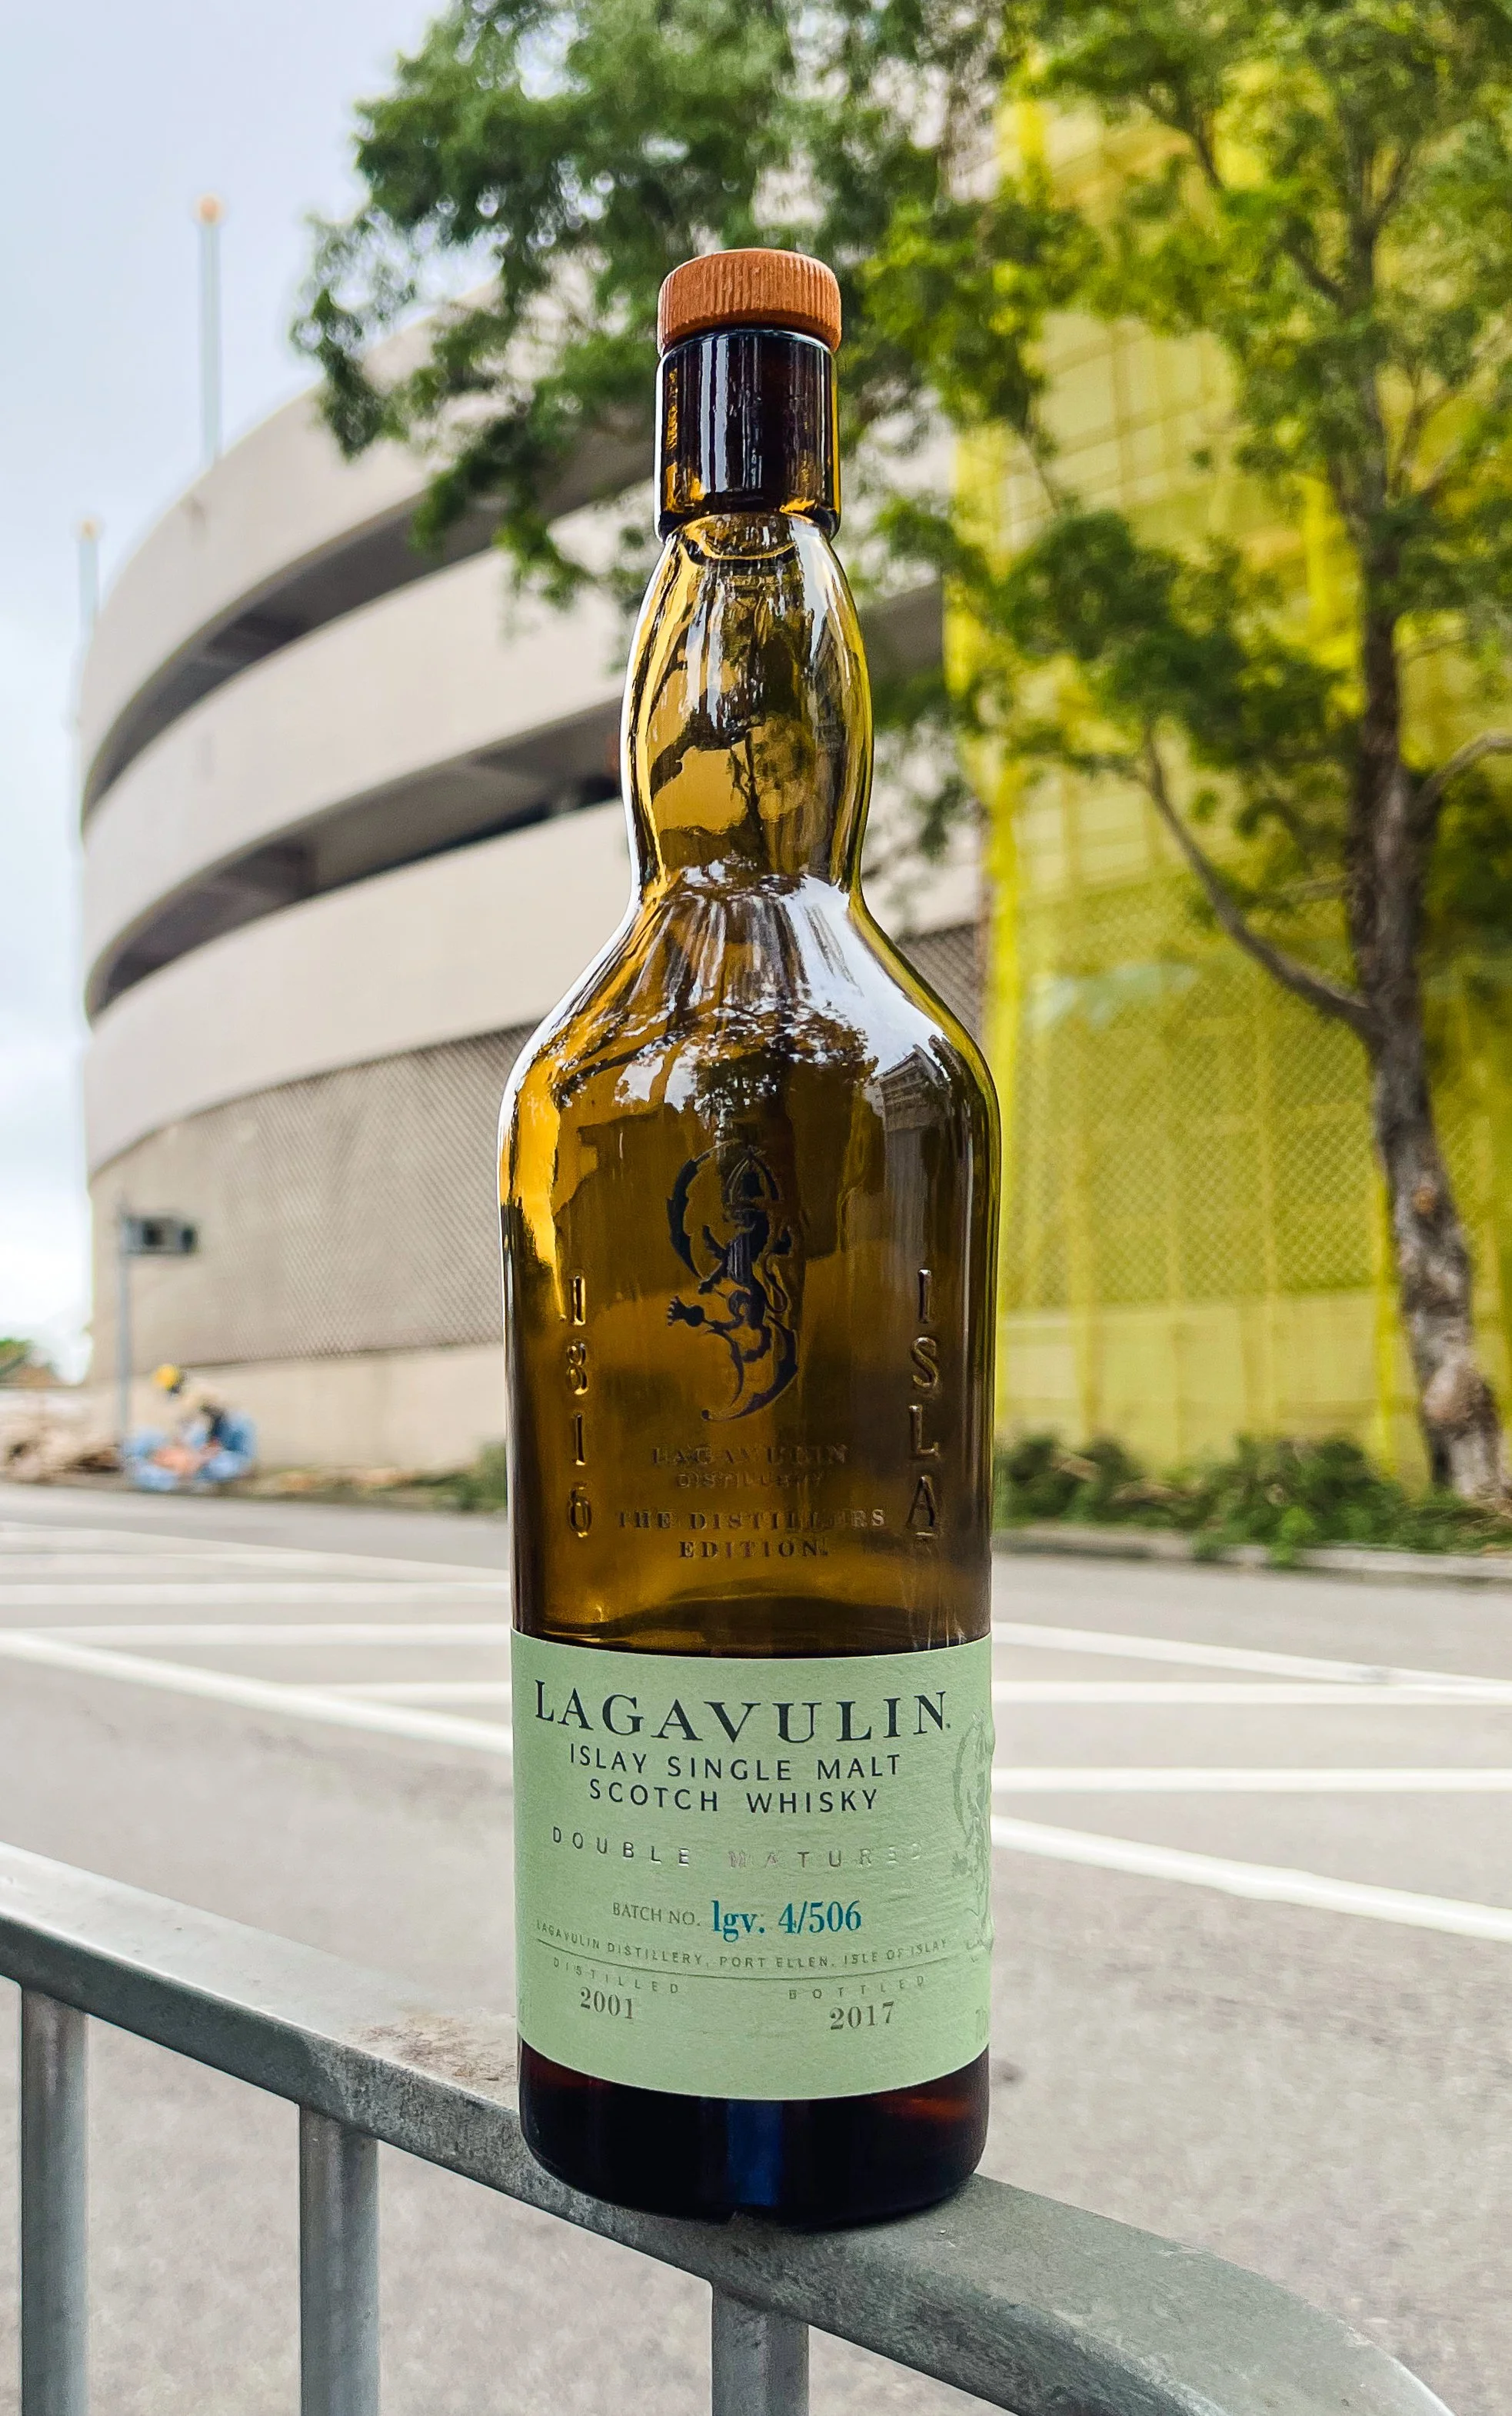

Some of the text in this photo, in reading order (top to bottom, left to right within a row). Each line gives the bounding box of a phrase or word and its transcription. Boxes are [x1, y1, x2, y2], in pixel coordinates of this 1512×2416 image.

[618, 1509, 672, 1529] THE
[570, 1743, 900, 1781] ISLAY SINGLE MALT
[589, 1778, 877, 1814] SCOTCH WHISKY
[552, 1826, 690, 1866] DOUBLE
[612, 1900, 862, 1942] BATCH NO. lgv. 4/506
[536, 1919, 600, 1949] LAGAVULIN
[719, 1955, 766, 1968] PORT
[844, 1951, 878, 1966] ISLE
[886, 1947, 905, 1961] OF
[553, 1958, 679, 1994] DISTILLED
[788, 1974, 924, 2000] BOTTLED
[579, 1986, 634, 2019] 2001
[829, 2001, 895, 2031] 2017
